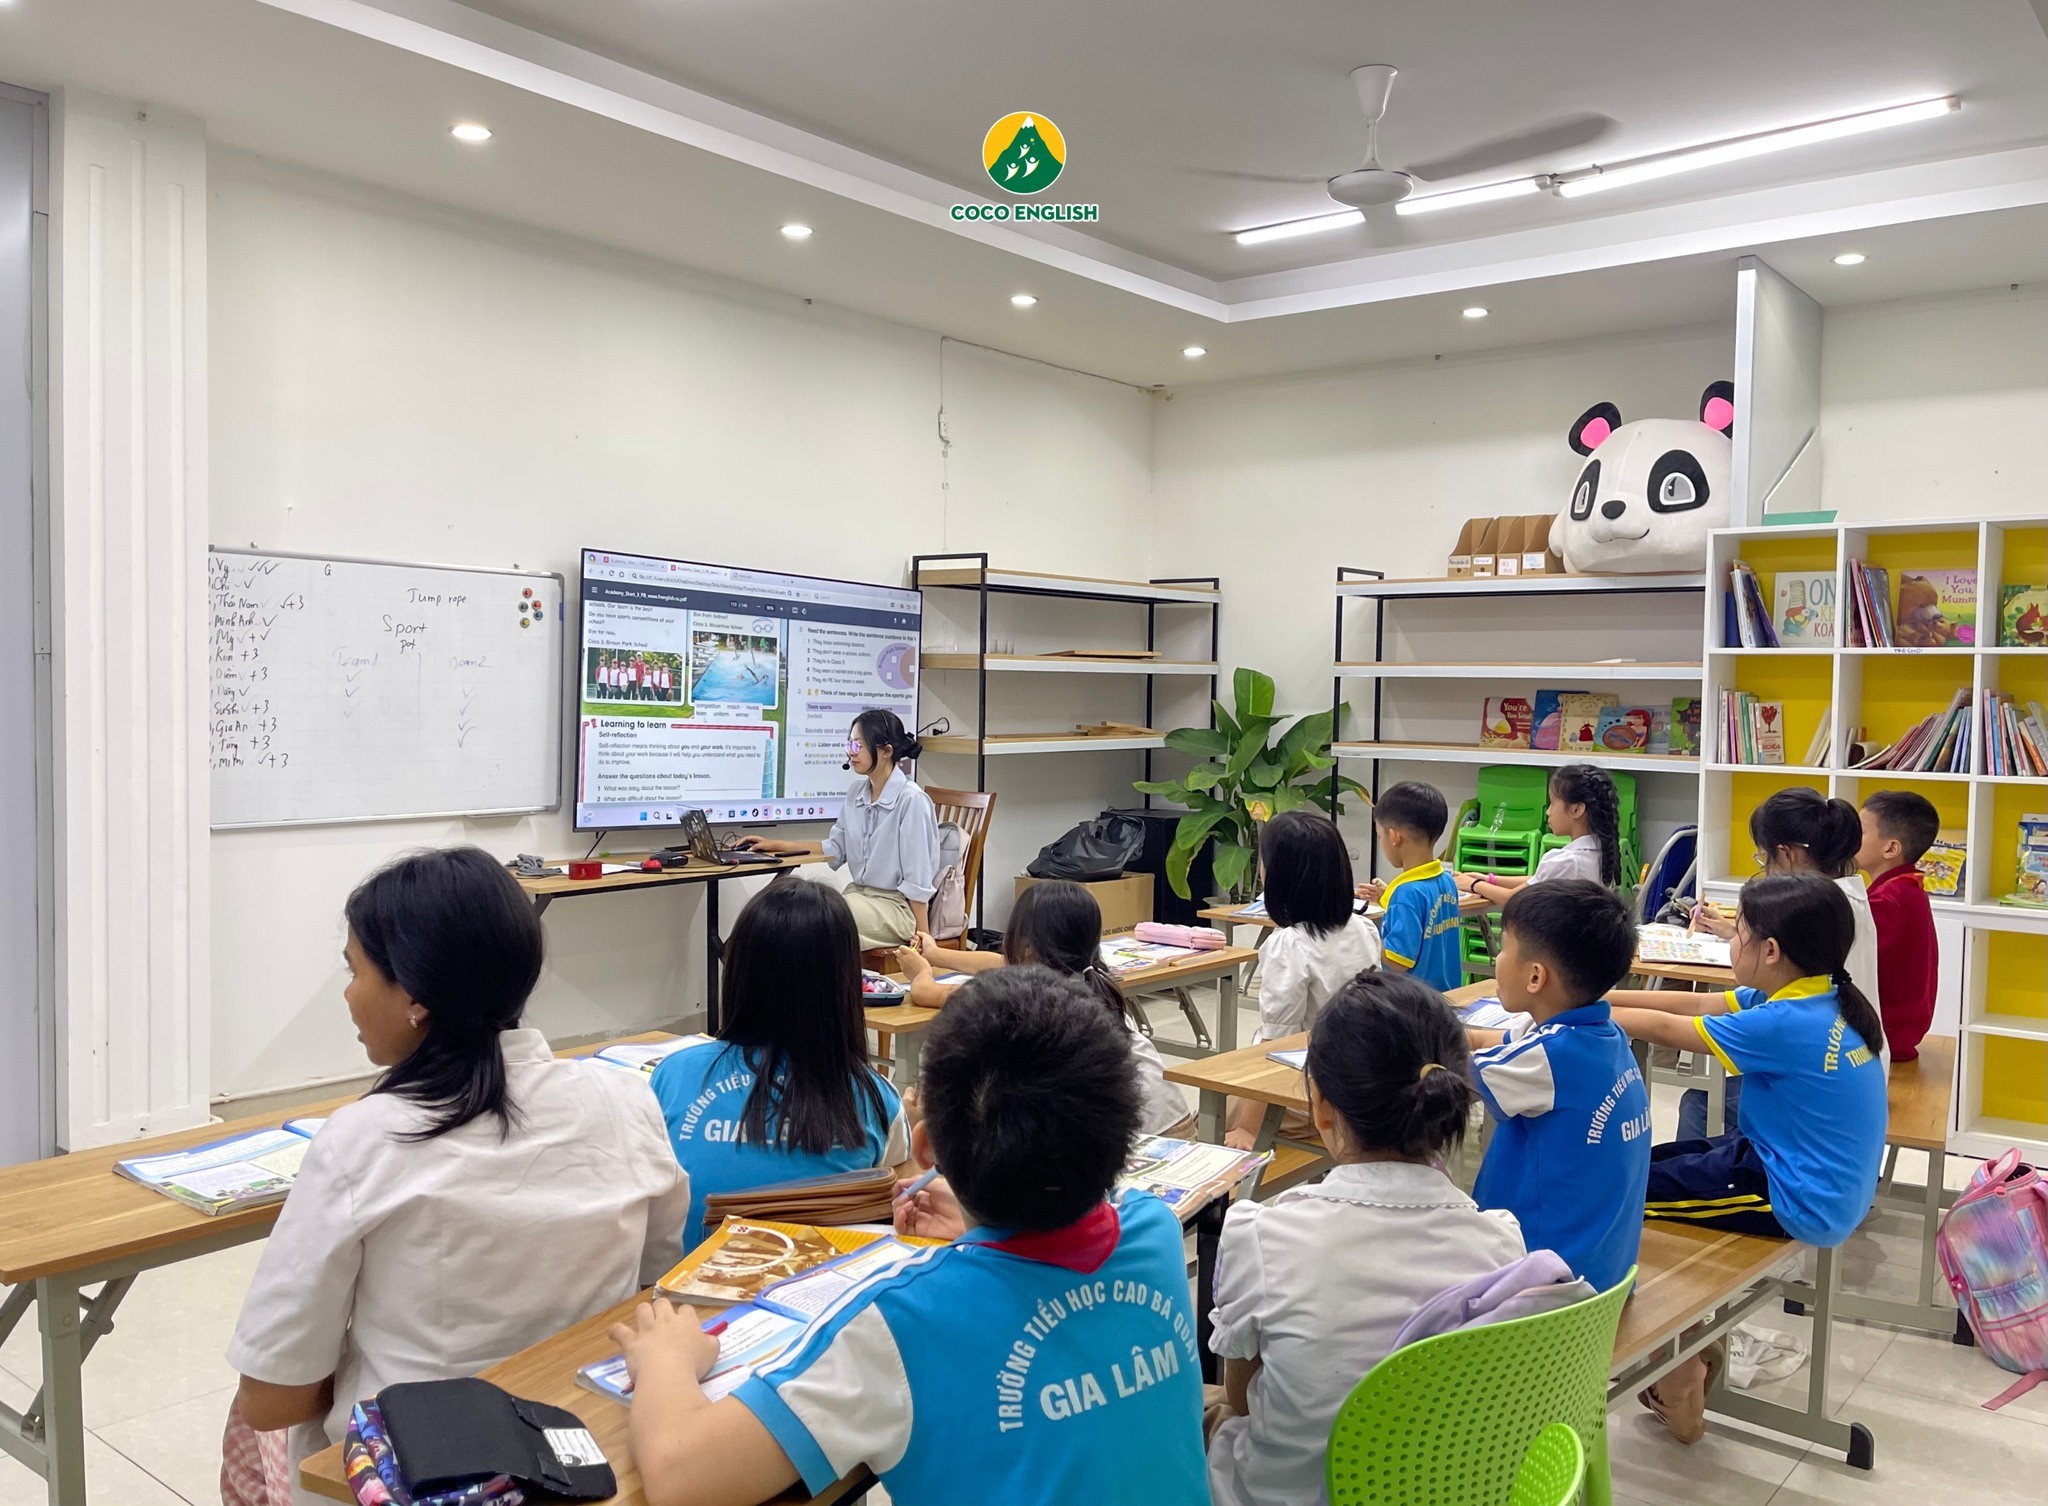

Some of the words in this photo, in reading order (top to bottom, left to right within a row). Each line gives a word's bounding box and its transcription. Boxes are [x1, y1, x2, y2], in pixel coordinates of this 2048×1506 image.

[1809, 578, 1836, 606] ON
[1946, 576, 1950, 584] I
[407, 588, 442, 606] Jump
[448, 595, 467, 606] rope
[1942, 595, 1977, 604] Mumm
[382, 614, 428, 638] Sport
[1814, 622, 1834, 638] KOA
[1503, 702, 1528, 712] You're
[600, 720, 636, 730] Learning
[637, 720, 645, 728] to
[646, 720, 667, 729] learn
[678, 1088, 717, 1142] TRƯỜNG
[716, 1070, 750, 1094] TIỂU
[704, 1118, 748, 1143] GIA
[1586, 1094, 1616, 1145] TRƯỜNG
[1621, 1117, 1640, 1142] GIA
[1640, 1106, 1652, 1133] LÂ
[996, 1340, 1036, 1433] TRƯỜNG
[1023, 1298, 1067, 1342] TIỂU
[1064, 1280, 1106, 1312] HỌC
[1113, 1280, 1148, 1306] CAO
[1150, 1290, 1174, 1320] BÁ
[1040, 1372, 1108, 1422] GIA
[1110, 1340, 1180, 1399] LÂM
